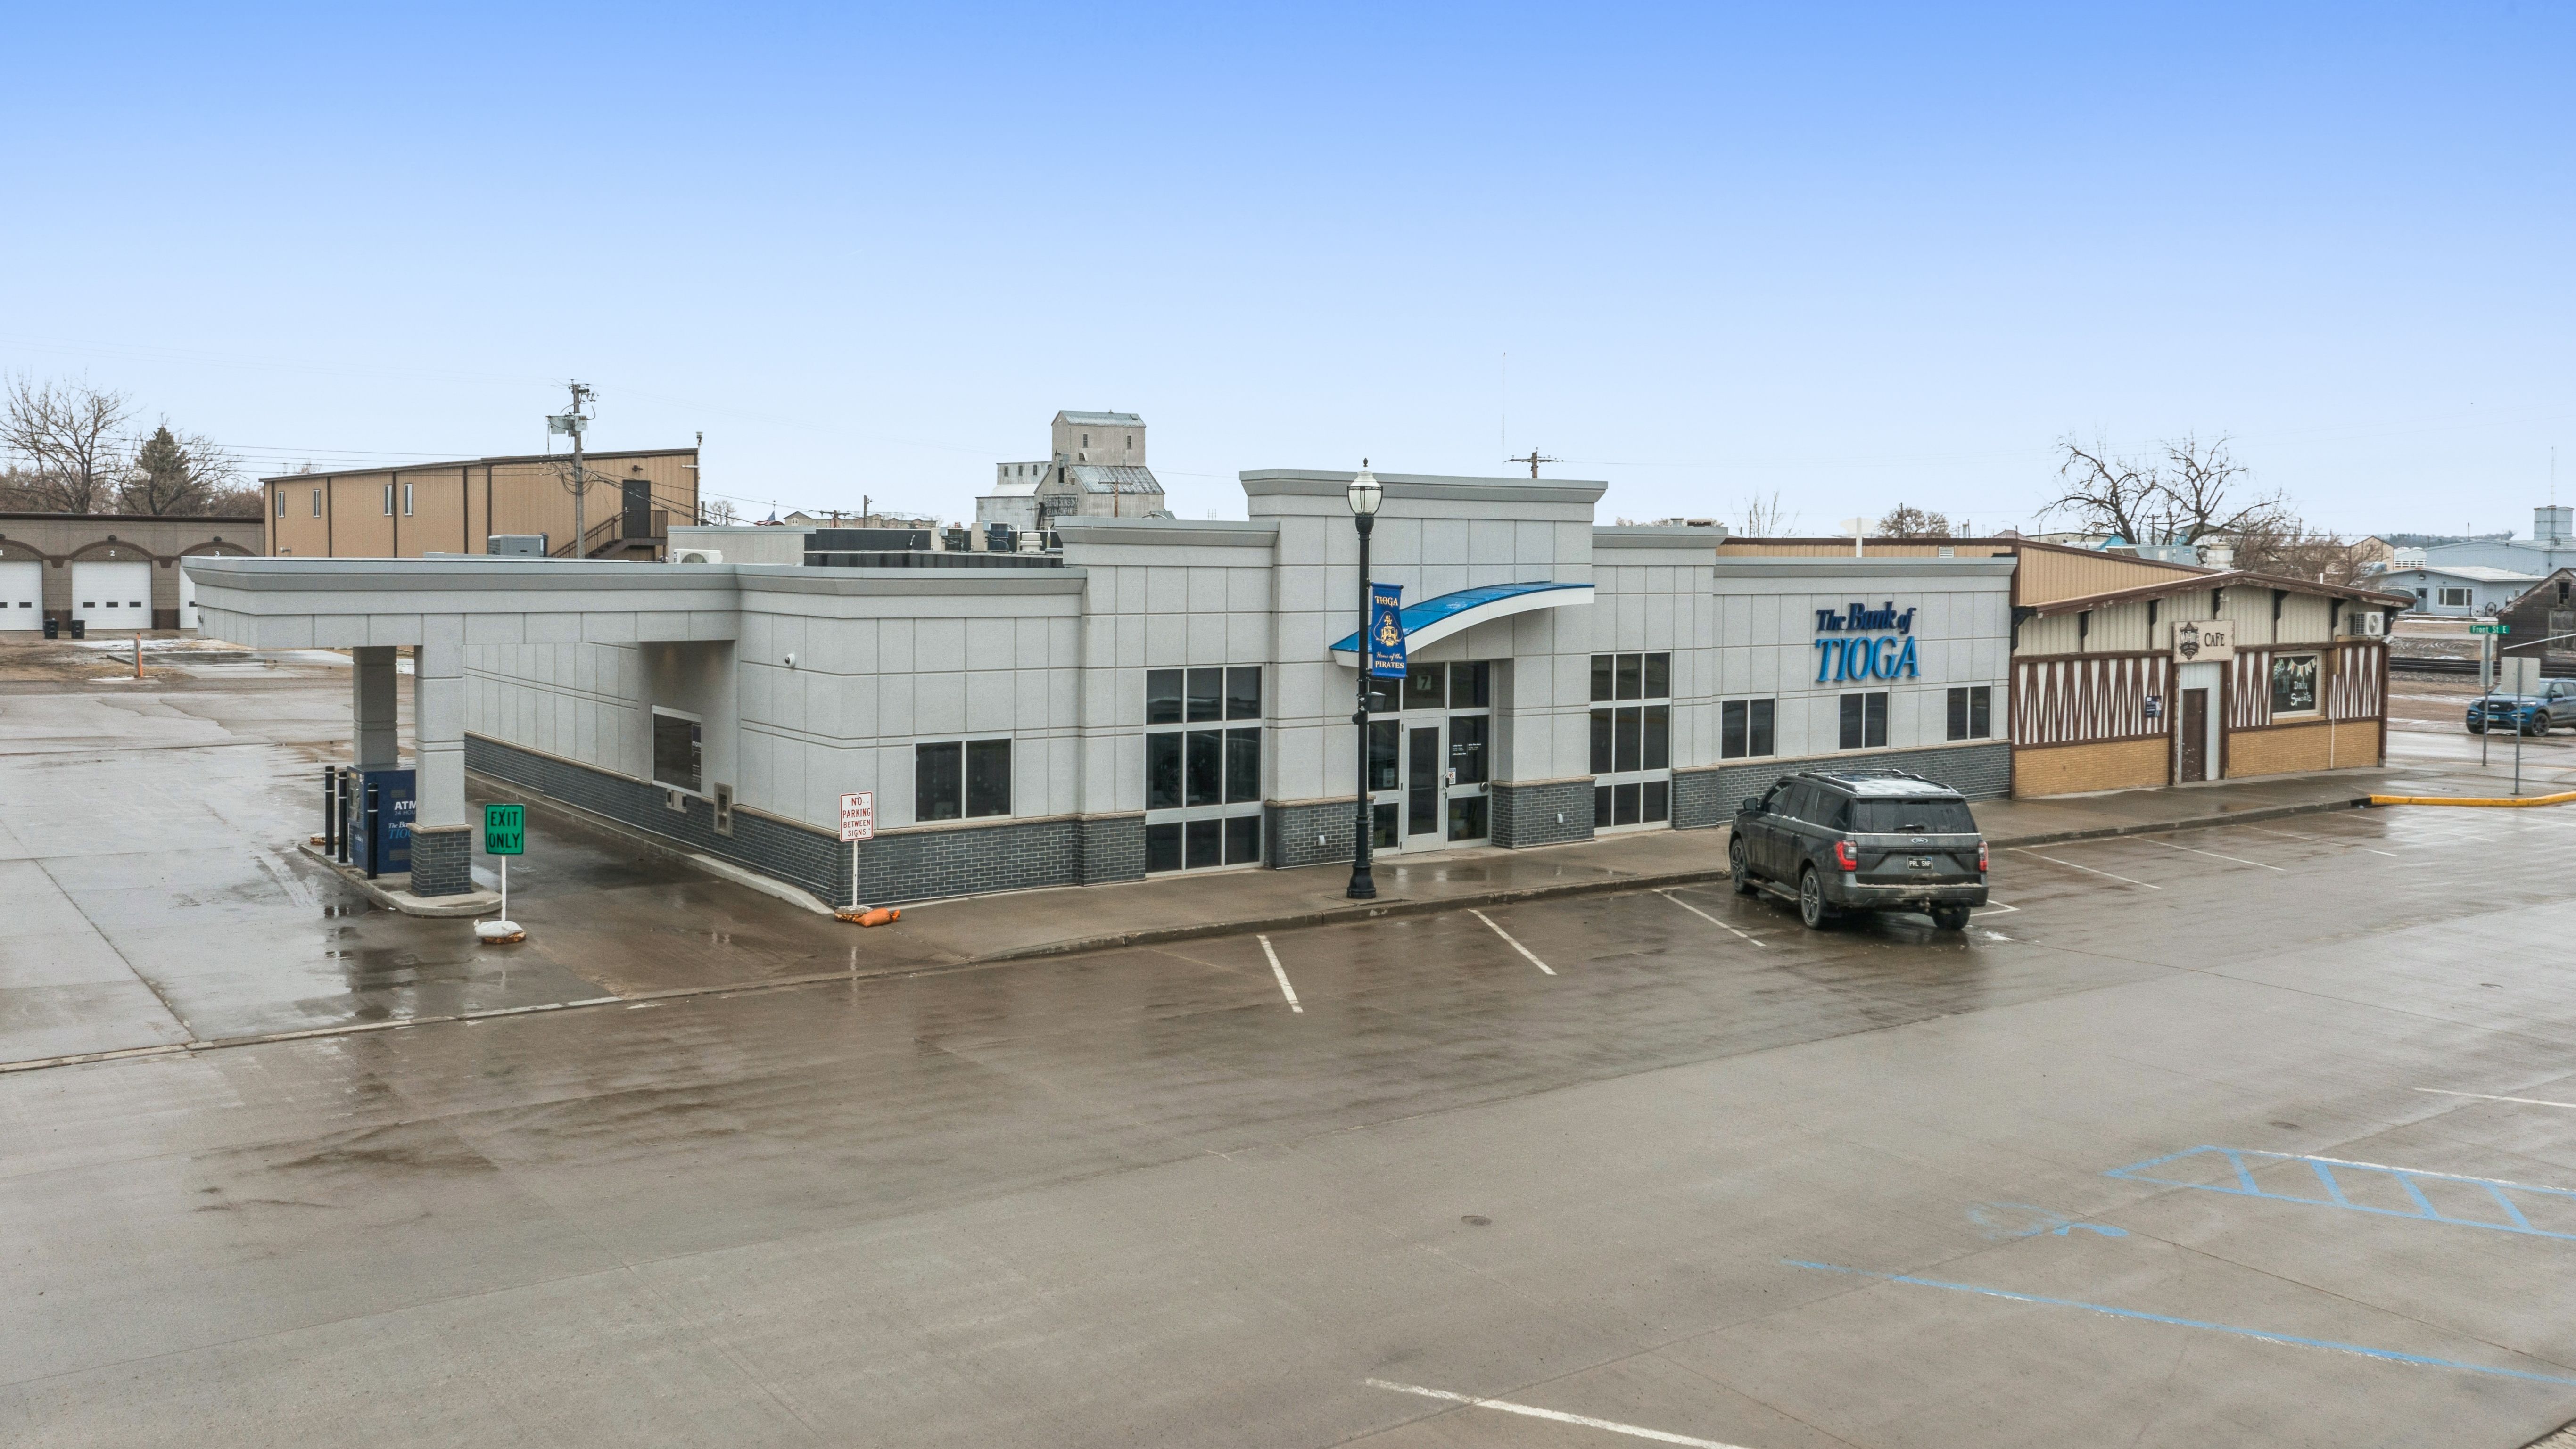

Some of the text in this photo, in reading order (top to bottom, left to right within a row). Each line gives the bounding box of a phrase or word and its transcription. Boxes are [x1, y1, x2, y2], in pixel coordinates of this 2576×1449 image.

[1054, 498, 1076, 507] DIKINSON
[1374, 595, 1398, 607] TIOGA
[1816, 601, 1917, 635] The Bank of
[2472, 626, 2507, 634] Front St E
[1389, 653, 1395, 662] of
[1815, 635, 1921, 682] TIOGA
[1375, 661, 1404, 669] PIRATES
[1421, 676, 1429, 689] 7
[394, 800, 417, 810] ATM
[851, 797, 862, 806] NO
[842, 807, 871, 818] PARKING
[491, 811, 518, 827] EXIT
[843, 819, 871, 828] BETWEEN
[388, 828, 411, 839] TIO
[848, 829, 867, 837] SIGNS
[488, 833, 520, 848] ONLY
